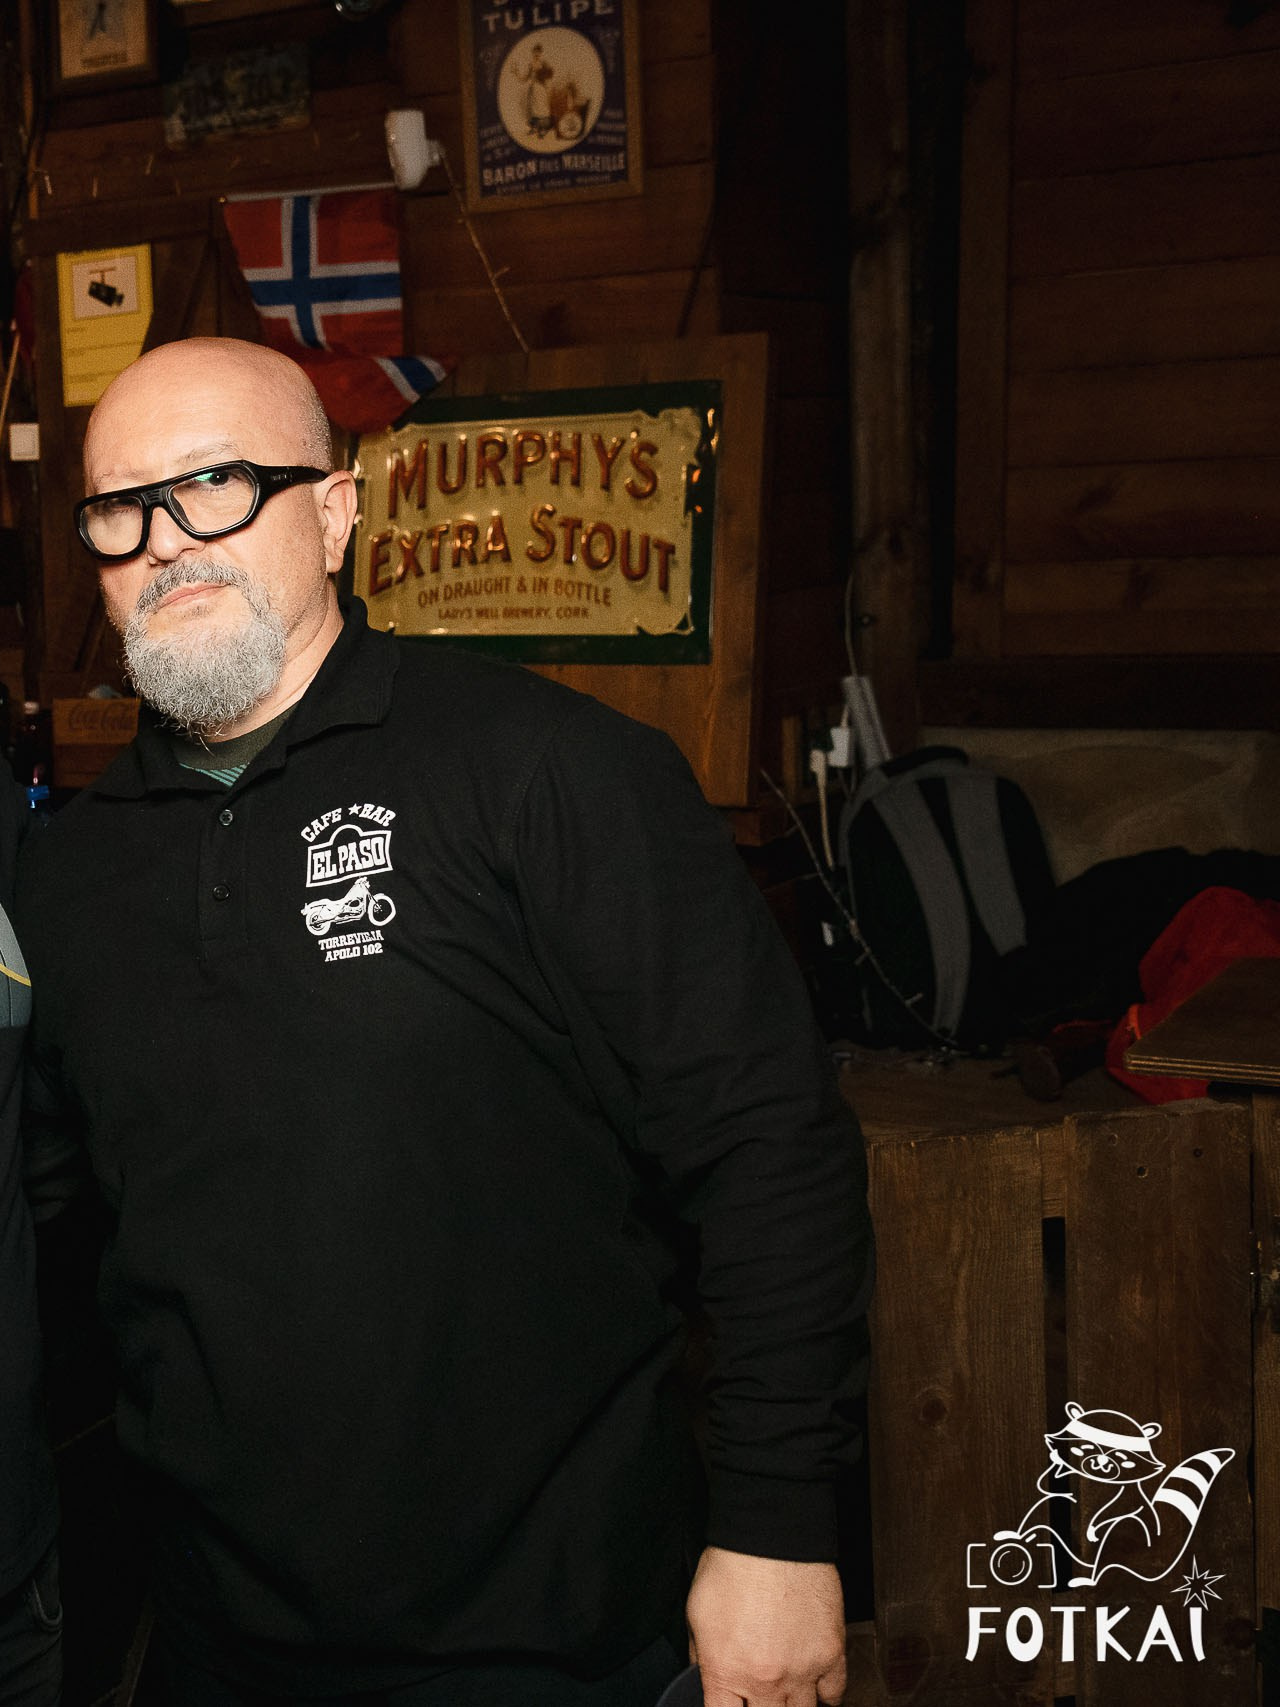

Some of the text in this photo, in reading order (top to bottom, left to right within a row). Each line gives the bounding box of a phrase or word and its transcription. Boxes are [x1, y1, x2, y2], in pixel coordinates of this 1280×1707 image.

[482, 0, 615, 33] TULIPE
[482, 158, 538, 187] BARON
[387, 426, 660, 519] MURPHY'S
[369, 504, 676, 596] EXTRA STOUT
[418, 576, 612, 608] ON DRAUGHT & IN BOTTLE
[476, 608, 500, 621] WELL
[300, 803, 397, 843] CAFE BAR
[312, 836, 386, 880] EL PASO
[318, 929, 384, 951] TORREVIEJA
[324, 942, 384, 963] APOLO 102
